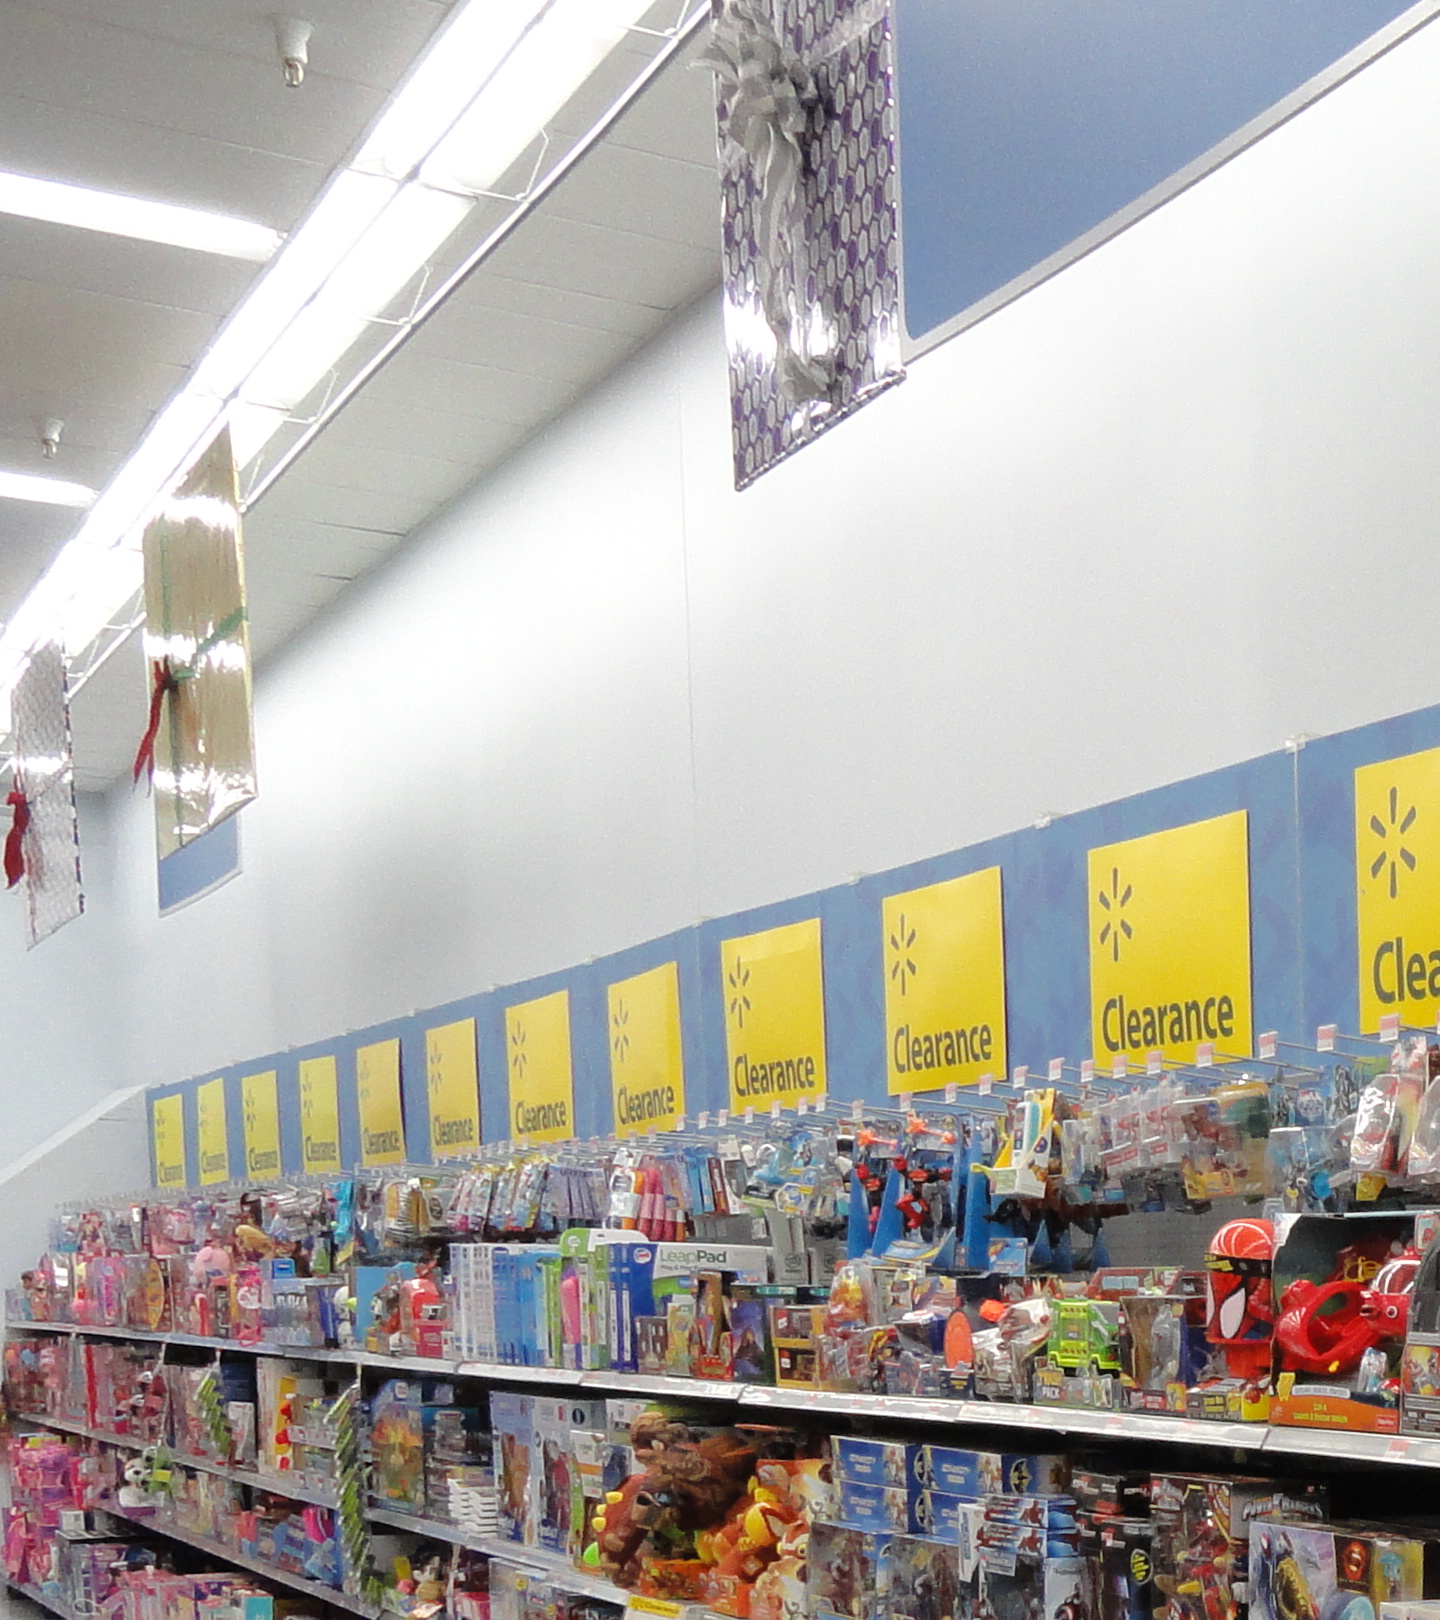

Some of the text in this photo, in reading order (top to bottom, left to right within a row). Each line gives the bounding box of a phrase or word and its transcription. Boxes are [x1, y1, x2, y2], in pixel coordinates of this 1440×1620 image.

[1103, 996, 1234, 1052] Clearance
[894, 1024, 991, 1074] Clearance
[734, 1054, 815, 1096] Clearance
[516, 1100, 566, 1132] Clearance
[617, 1084, 675, 1125] Clearance
[363, 1127, 400, 1153] Clearance
[433, 1117, 473, 1143] Clearance
[306, 1136, 336, 1162] Clearance
[660, 1250, 727, 1263] LeapPad
